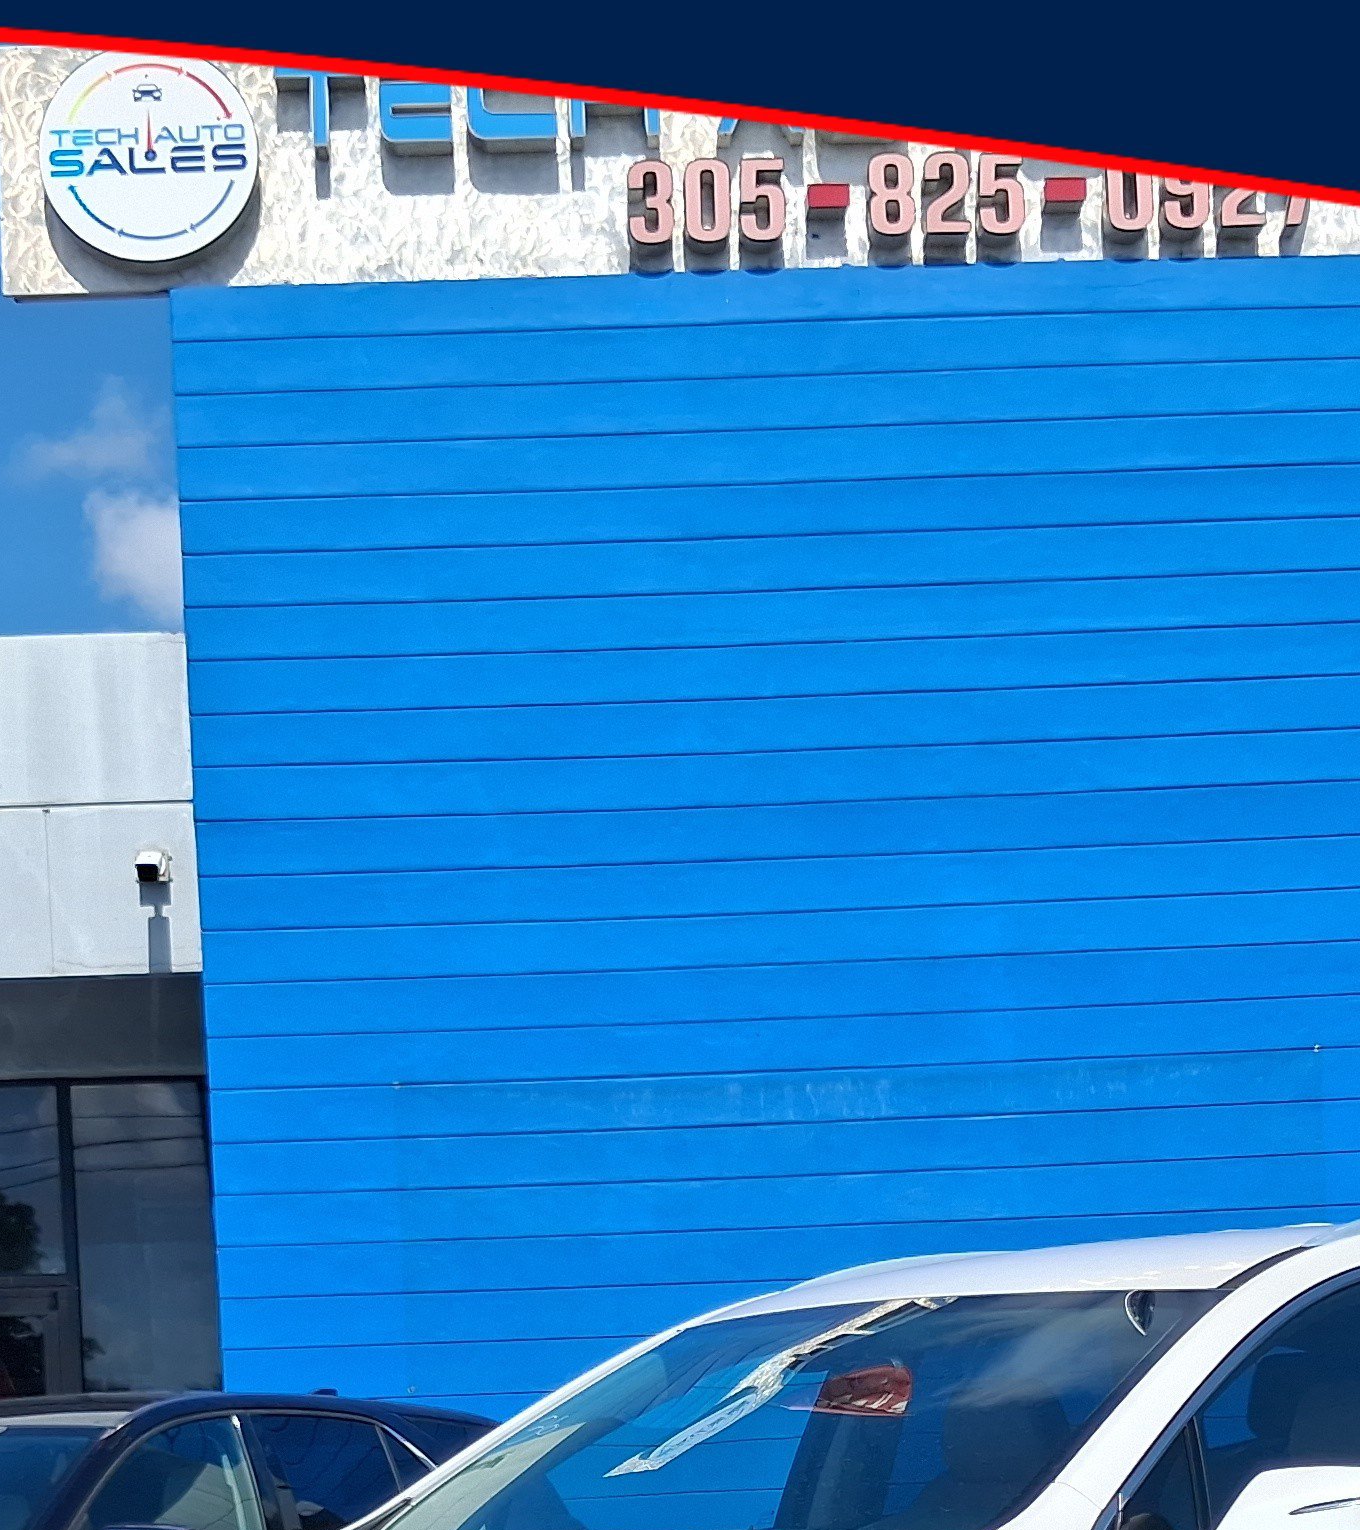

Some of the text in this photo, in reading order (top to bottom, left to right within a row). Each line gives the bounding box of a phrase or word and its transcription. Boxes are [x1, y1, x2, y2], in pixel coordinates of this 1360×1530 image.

[49, 123, 245, 147] TECH AUTO
[49, 144, 248, 177] SALES
